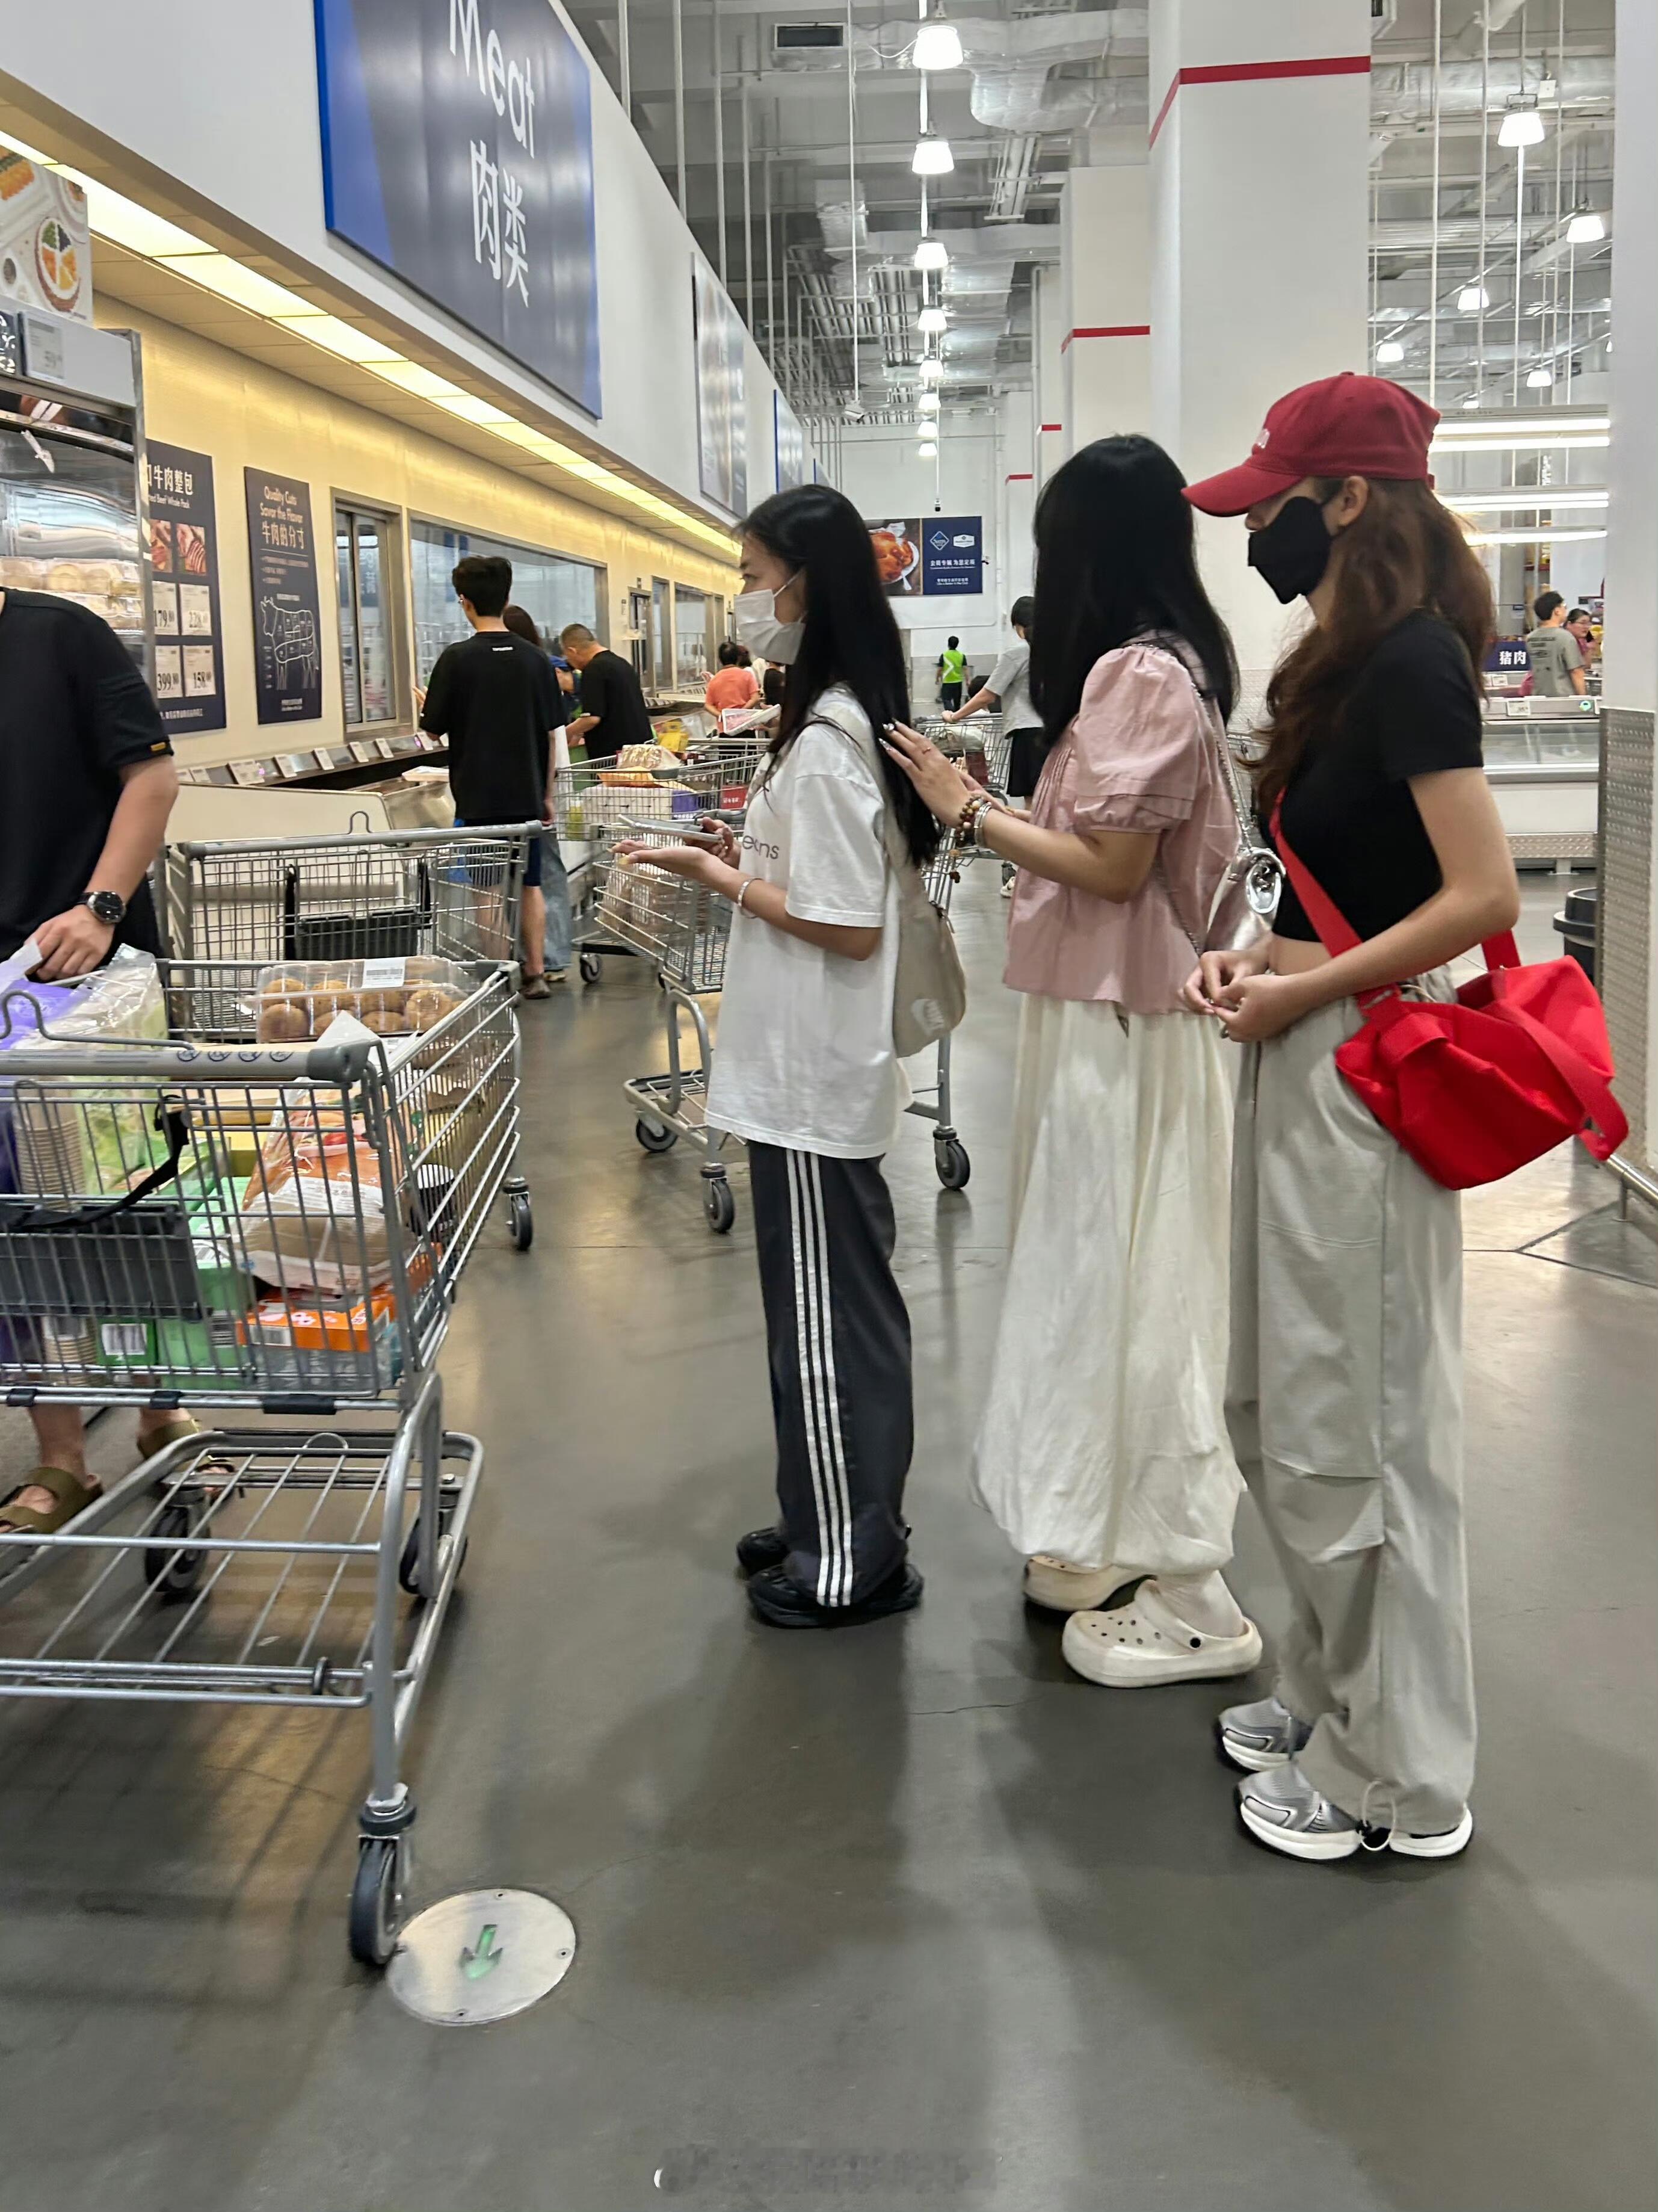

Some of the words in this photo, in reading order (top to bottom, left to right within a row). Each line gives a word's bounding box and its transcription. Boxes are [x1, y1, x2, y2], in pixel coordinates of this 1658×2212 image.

[449, 0, 535, 159] Meat
[470, 140, 529, 308] 肉类
[264, 486, 284, 505] Quality
[1499, 650, 1526, 665] 猪肉
